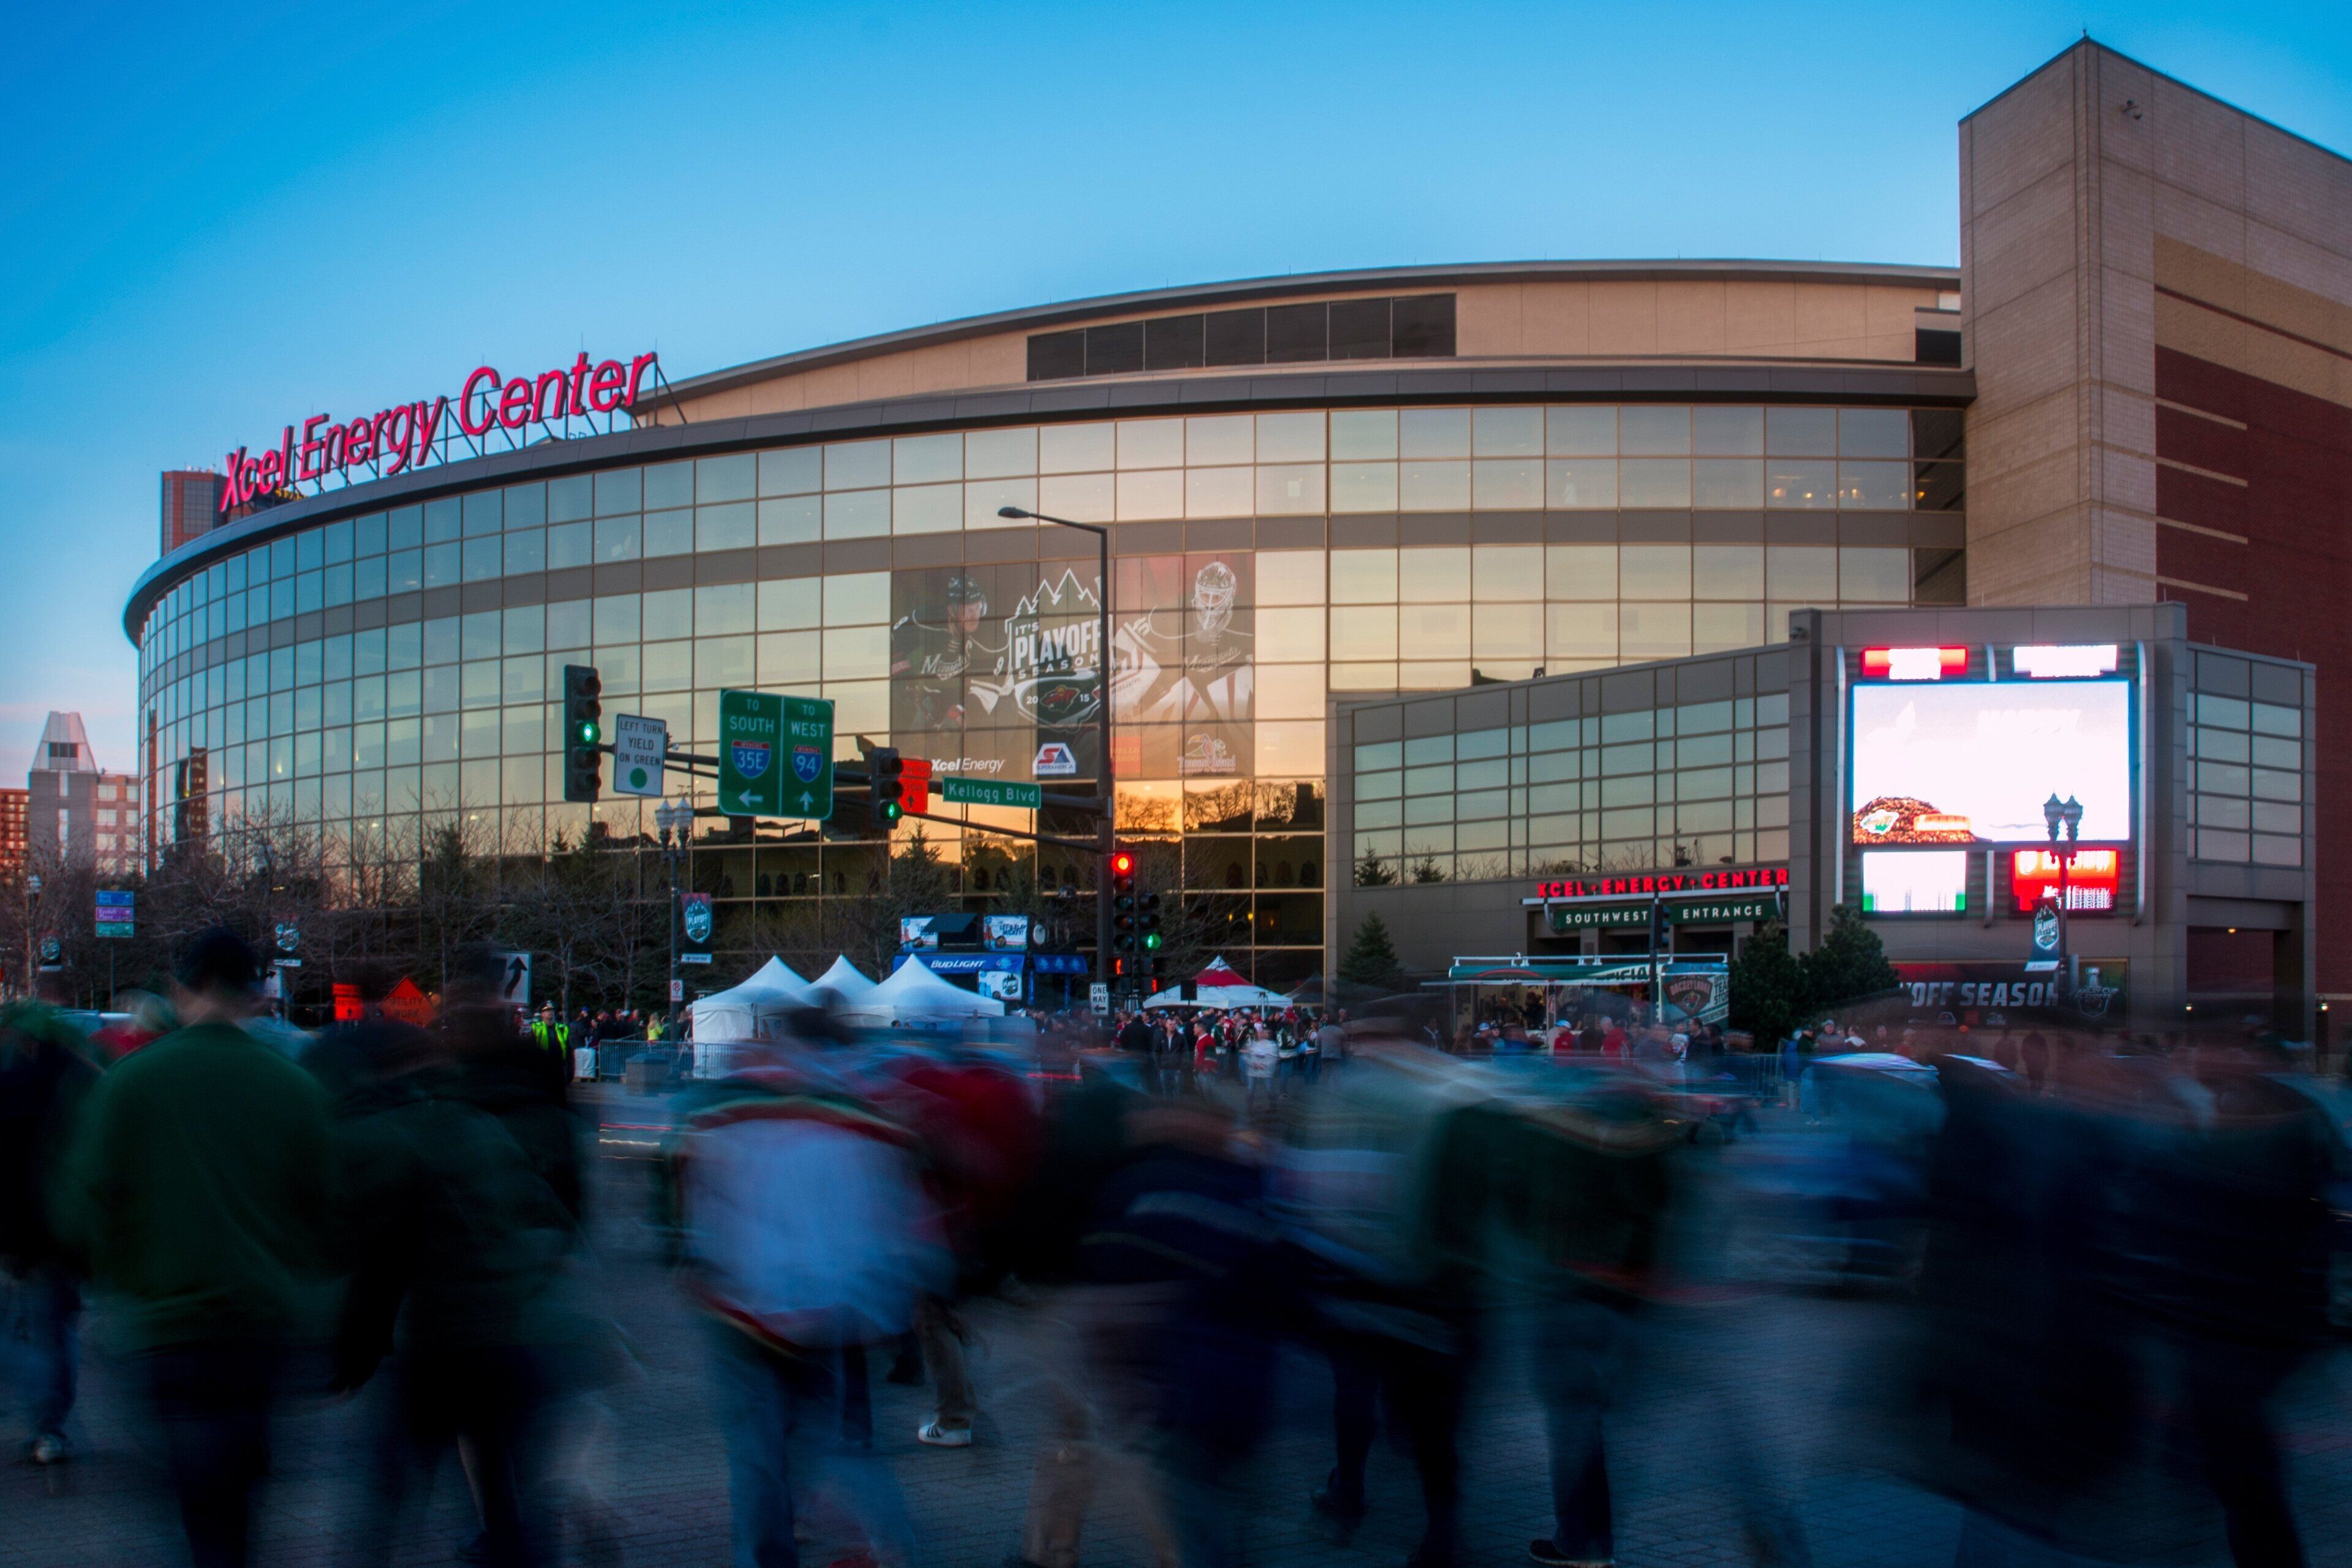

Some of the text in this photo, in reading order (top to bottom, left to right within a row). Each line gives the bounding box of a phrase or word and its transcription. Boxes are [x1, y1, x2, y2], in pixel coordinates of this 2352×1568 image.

[221, 352, 660, 513] Xcel Energy Center
[1016, 622, 1039, 636] IT'S
[1016, 619, 1101, 669] PLAYOFF
[1018, 652, 1098, 679] SEASON
[747, 699, 760, 710] TO
[802, 704, 815, 715] TO
[620, 720, 663, 734] LEFT TURN
[730, 716, 774, 734] SOUTH
[791, 721, 825, 737] WEST
[628, 737, 654, 750] YIELD
[619, 753, 660, 766] ON GREEN
[737, 751, 763, 769] 35E
[797, 755, 816, 773] 94
[932, 758, 960, 772] Xcel
[962, 758, 1005, 773] Energy
[949, 783, 1035, 803] Kellogg Blvd
[1537, 869, 1789, 899] XCEL ENERGY CENTER
[1566, 905, 1763, 924] SOUTHWEST ENTRANCE
[930, 960, 953, 968] BUD
[390, 997, 422, 1005] UTILITY
[1092, 995, 1107, 1003] WAY
